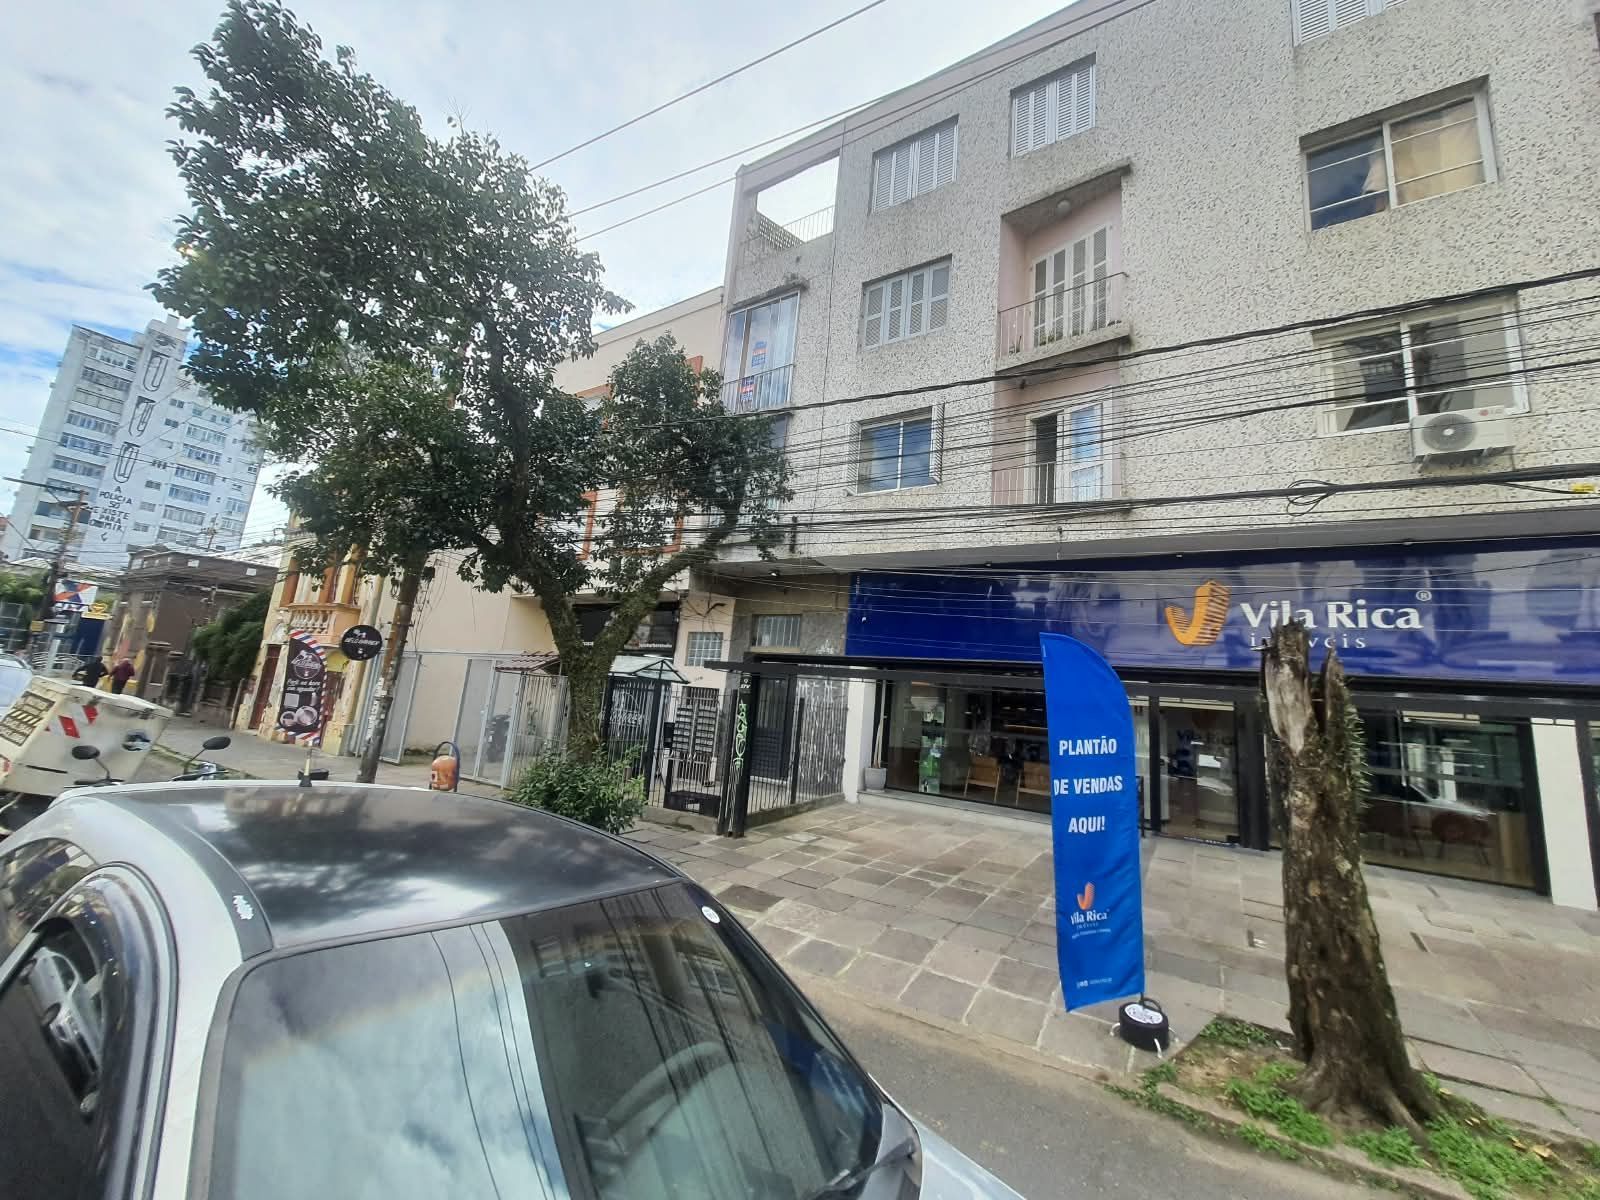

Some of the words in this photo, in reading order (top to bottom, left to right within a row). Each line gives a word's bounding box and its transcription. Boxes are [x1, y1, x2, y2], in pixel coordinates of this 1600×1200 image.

[1240, 600, 1318, 629] Vila
[1327, 599, 1424, 629] Rica
[1250, 633, 1366, 649] iveis
[1059, 735, 1117, 756] PLANTÃO
[1053, 778, 1069, 796] DE
[1073, 775, 1123, 795] VENDAS
[1068, 815, 1106, 835] AQUI!
[1070, 911, 1085, 926] Vila
[1086, 909, 1108, 922] Rica
